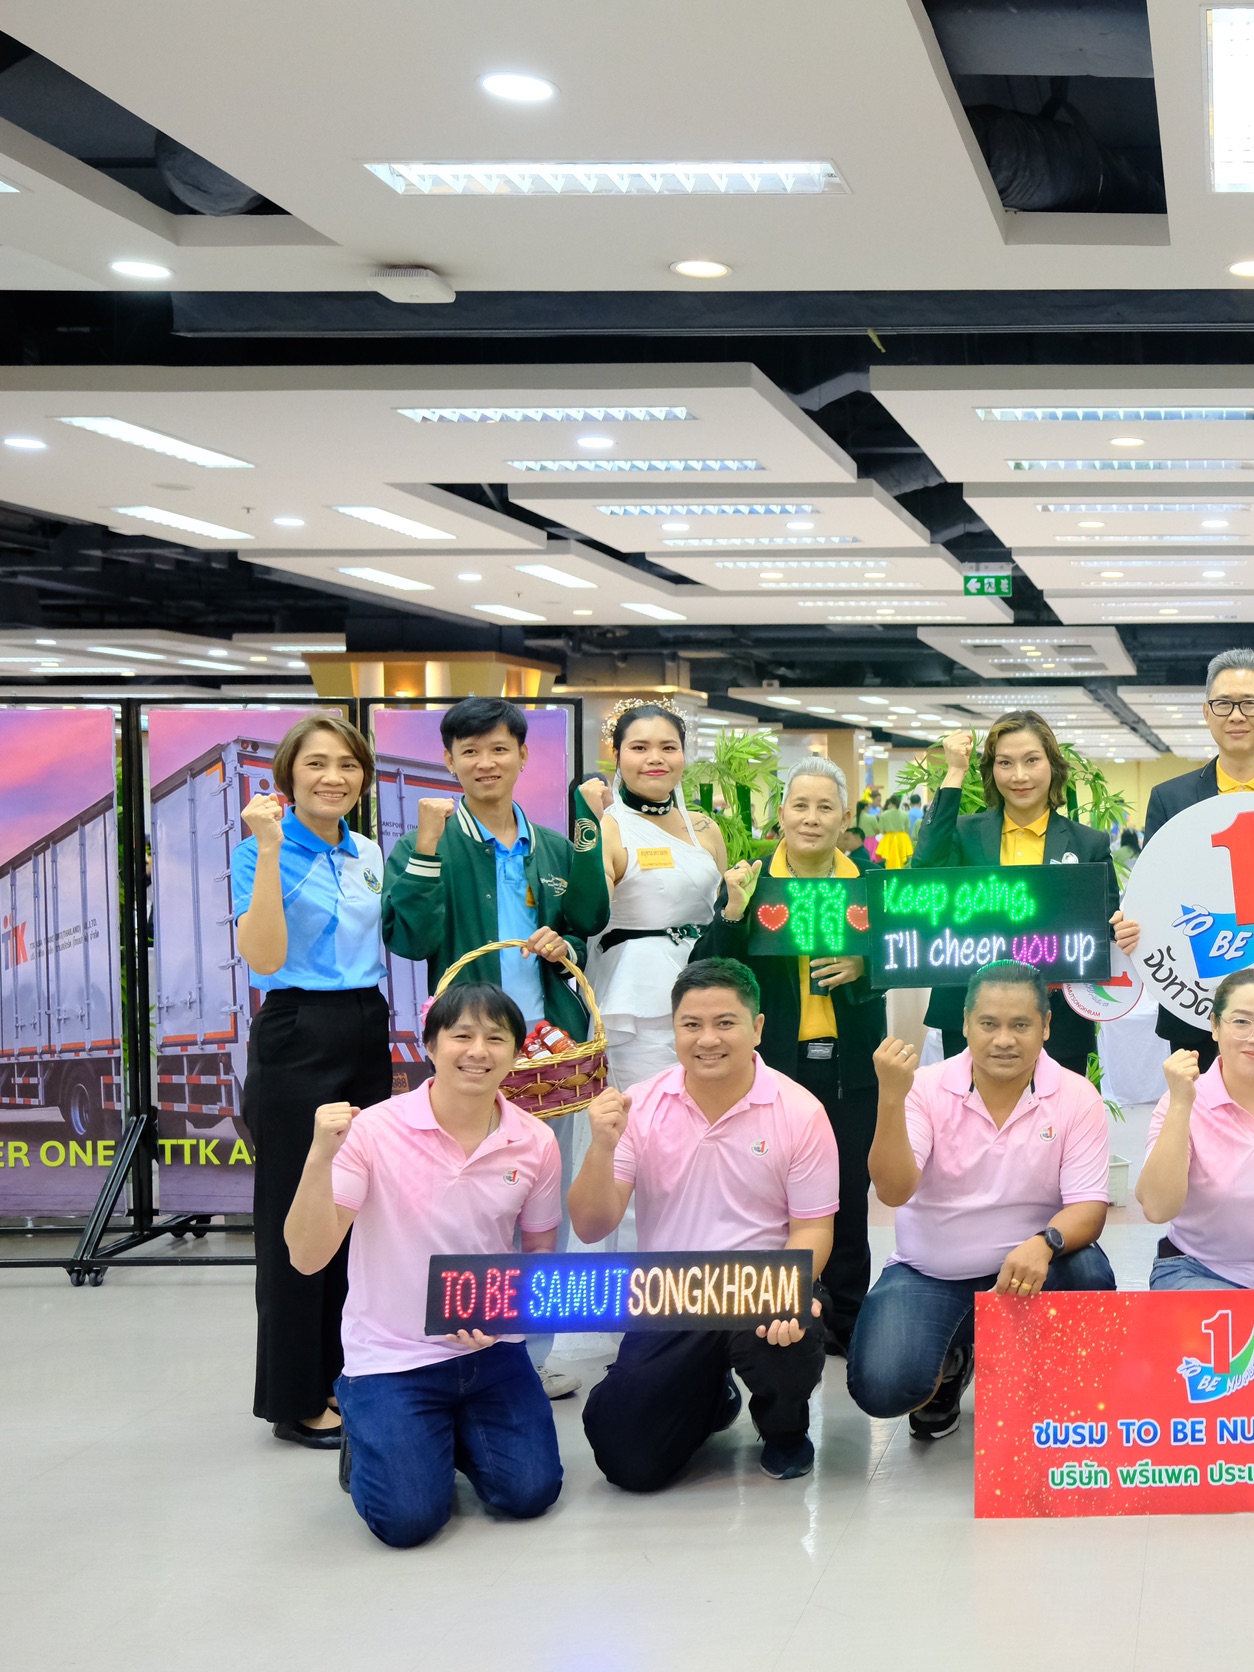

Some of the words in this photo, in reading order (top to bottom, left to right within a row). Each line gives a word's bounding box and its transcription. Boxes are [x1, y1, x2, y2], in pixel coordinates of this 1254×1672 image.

[883, 877, 947, 926] Keep
[953, 875, 1036, 924] going,
[884, 930, 919, 970] I'll
[929, 928, 1005, 967] cheer
[1011, 933, 1058, 967] you
[1064, 932, 1096, 976] up
[1171, 904, 1214, 938] TO
[1208, 930, 1253, 961] BE
[0, 1141, 30, 1168] R
[39, 1139, 117, 1167] ONE
[158, 1138, 221, 1166] TTK
[229, 1138, 257, 1166] A
[441, 1270, 477, 1320] TO
[484, 1267, 521, 1321] BE
[1202, 1310, 1231, 1374] 1
[1176, 1356, 1201, 1379] TO
[1197, 1374, 1223, 1393] BE
[1034, 1420, 1107, 1447] ชมรม
[1118, 1420, 1160, 1447] TO
[1171, 1418, 1206, 1444] BE
[1049, 1460, 1110, 1489] บริษัท
[1118, 1458, 1200, 1488] พรีแพค
